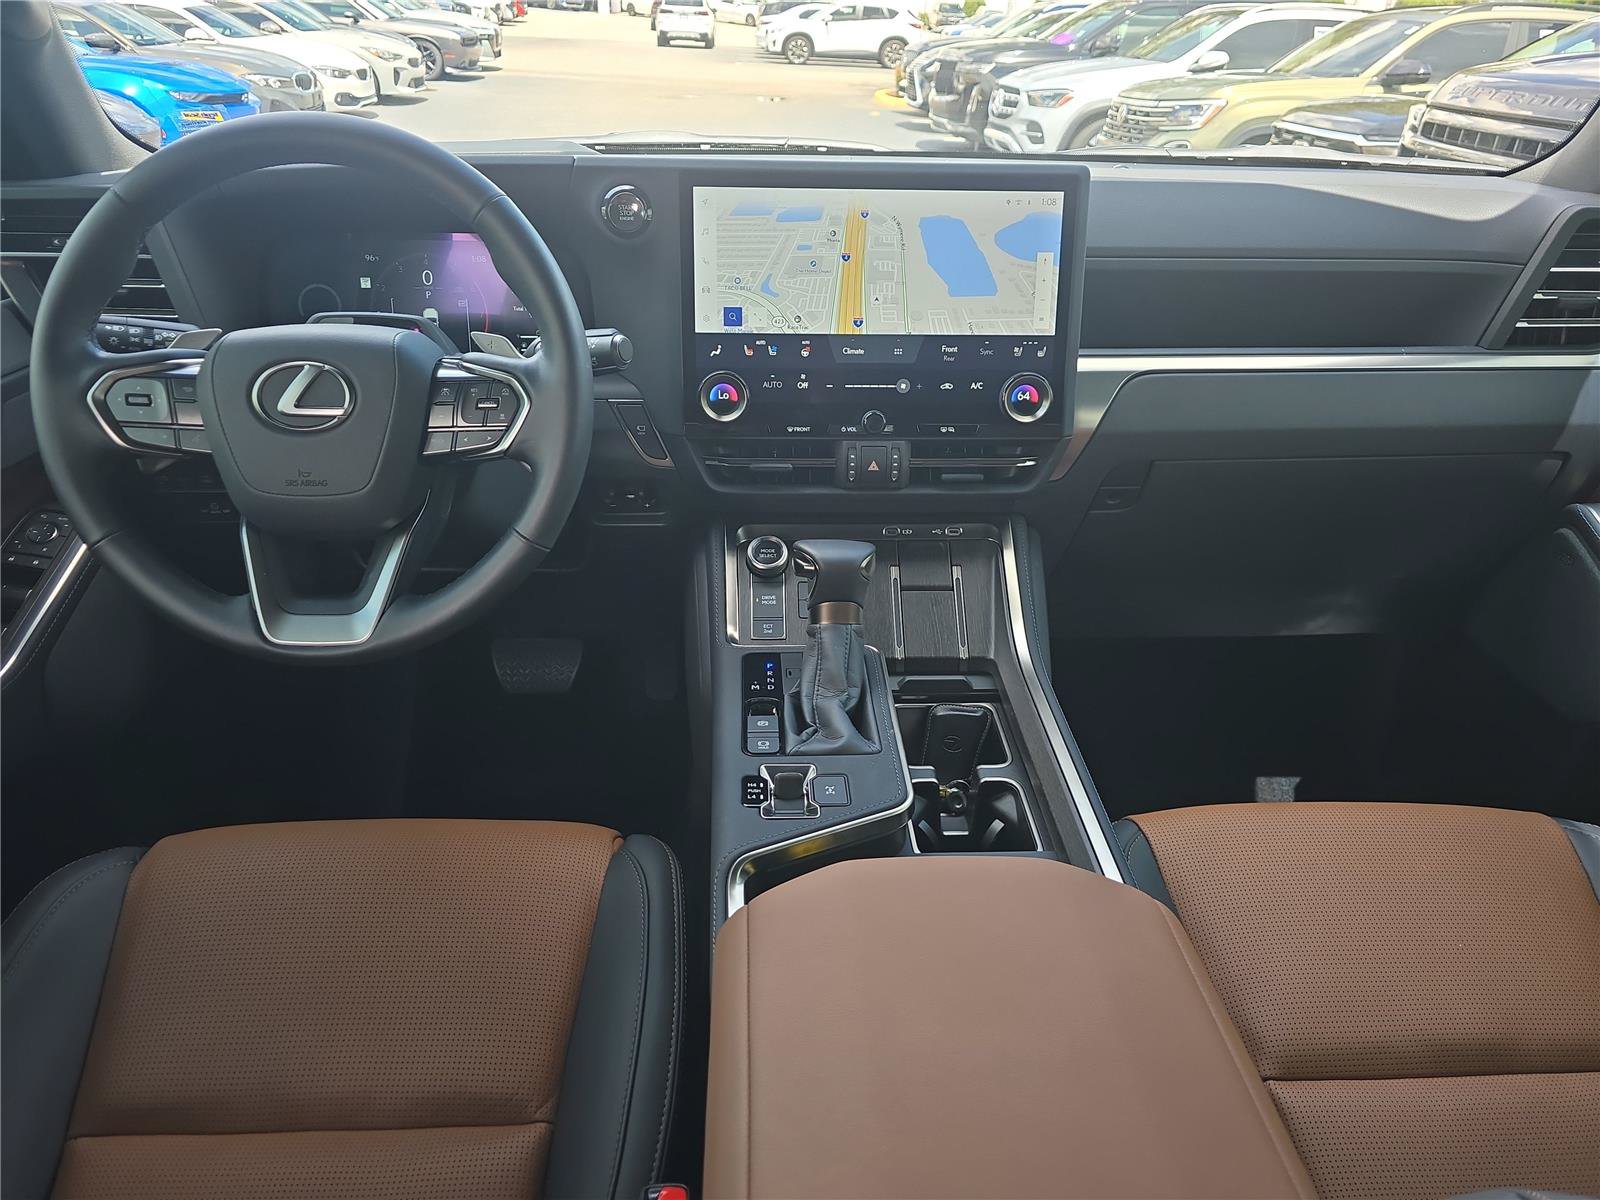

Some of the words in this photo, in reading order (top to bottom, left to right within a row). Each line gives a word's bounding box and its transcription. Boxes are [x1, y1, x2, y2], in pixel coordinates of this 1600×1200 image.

[422, 269, 433, 286] 0
[842, 347, 865, 355] Climate
[941, 345, 958, 353] Front
[979, 348, 994, 356] Sync
[797, 381, 809, 389] Off
[970, 382, 984, 390] A/C
[718, 390, 729, 400] Lo
[1017, 391, 1030, 400] 64
[284, 479, 299, 487] SRS
[300, 479, 328, 487] AIRBAG
